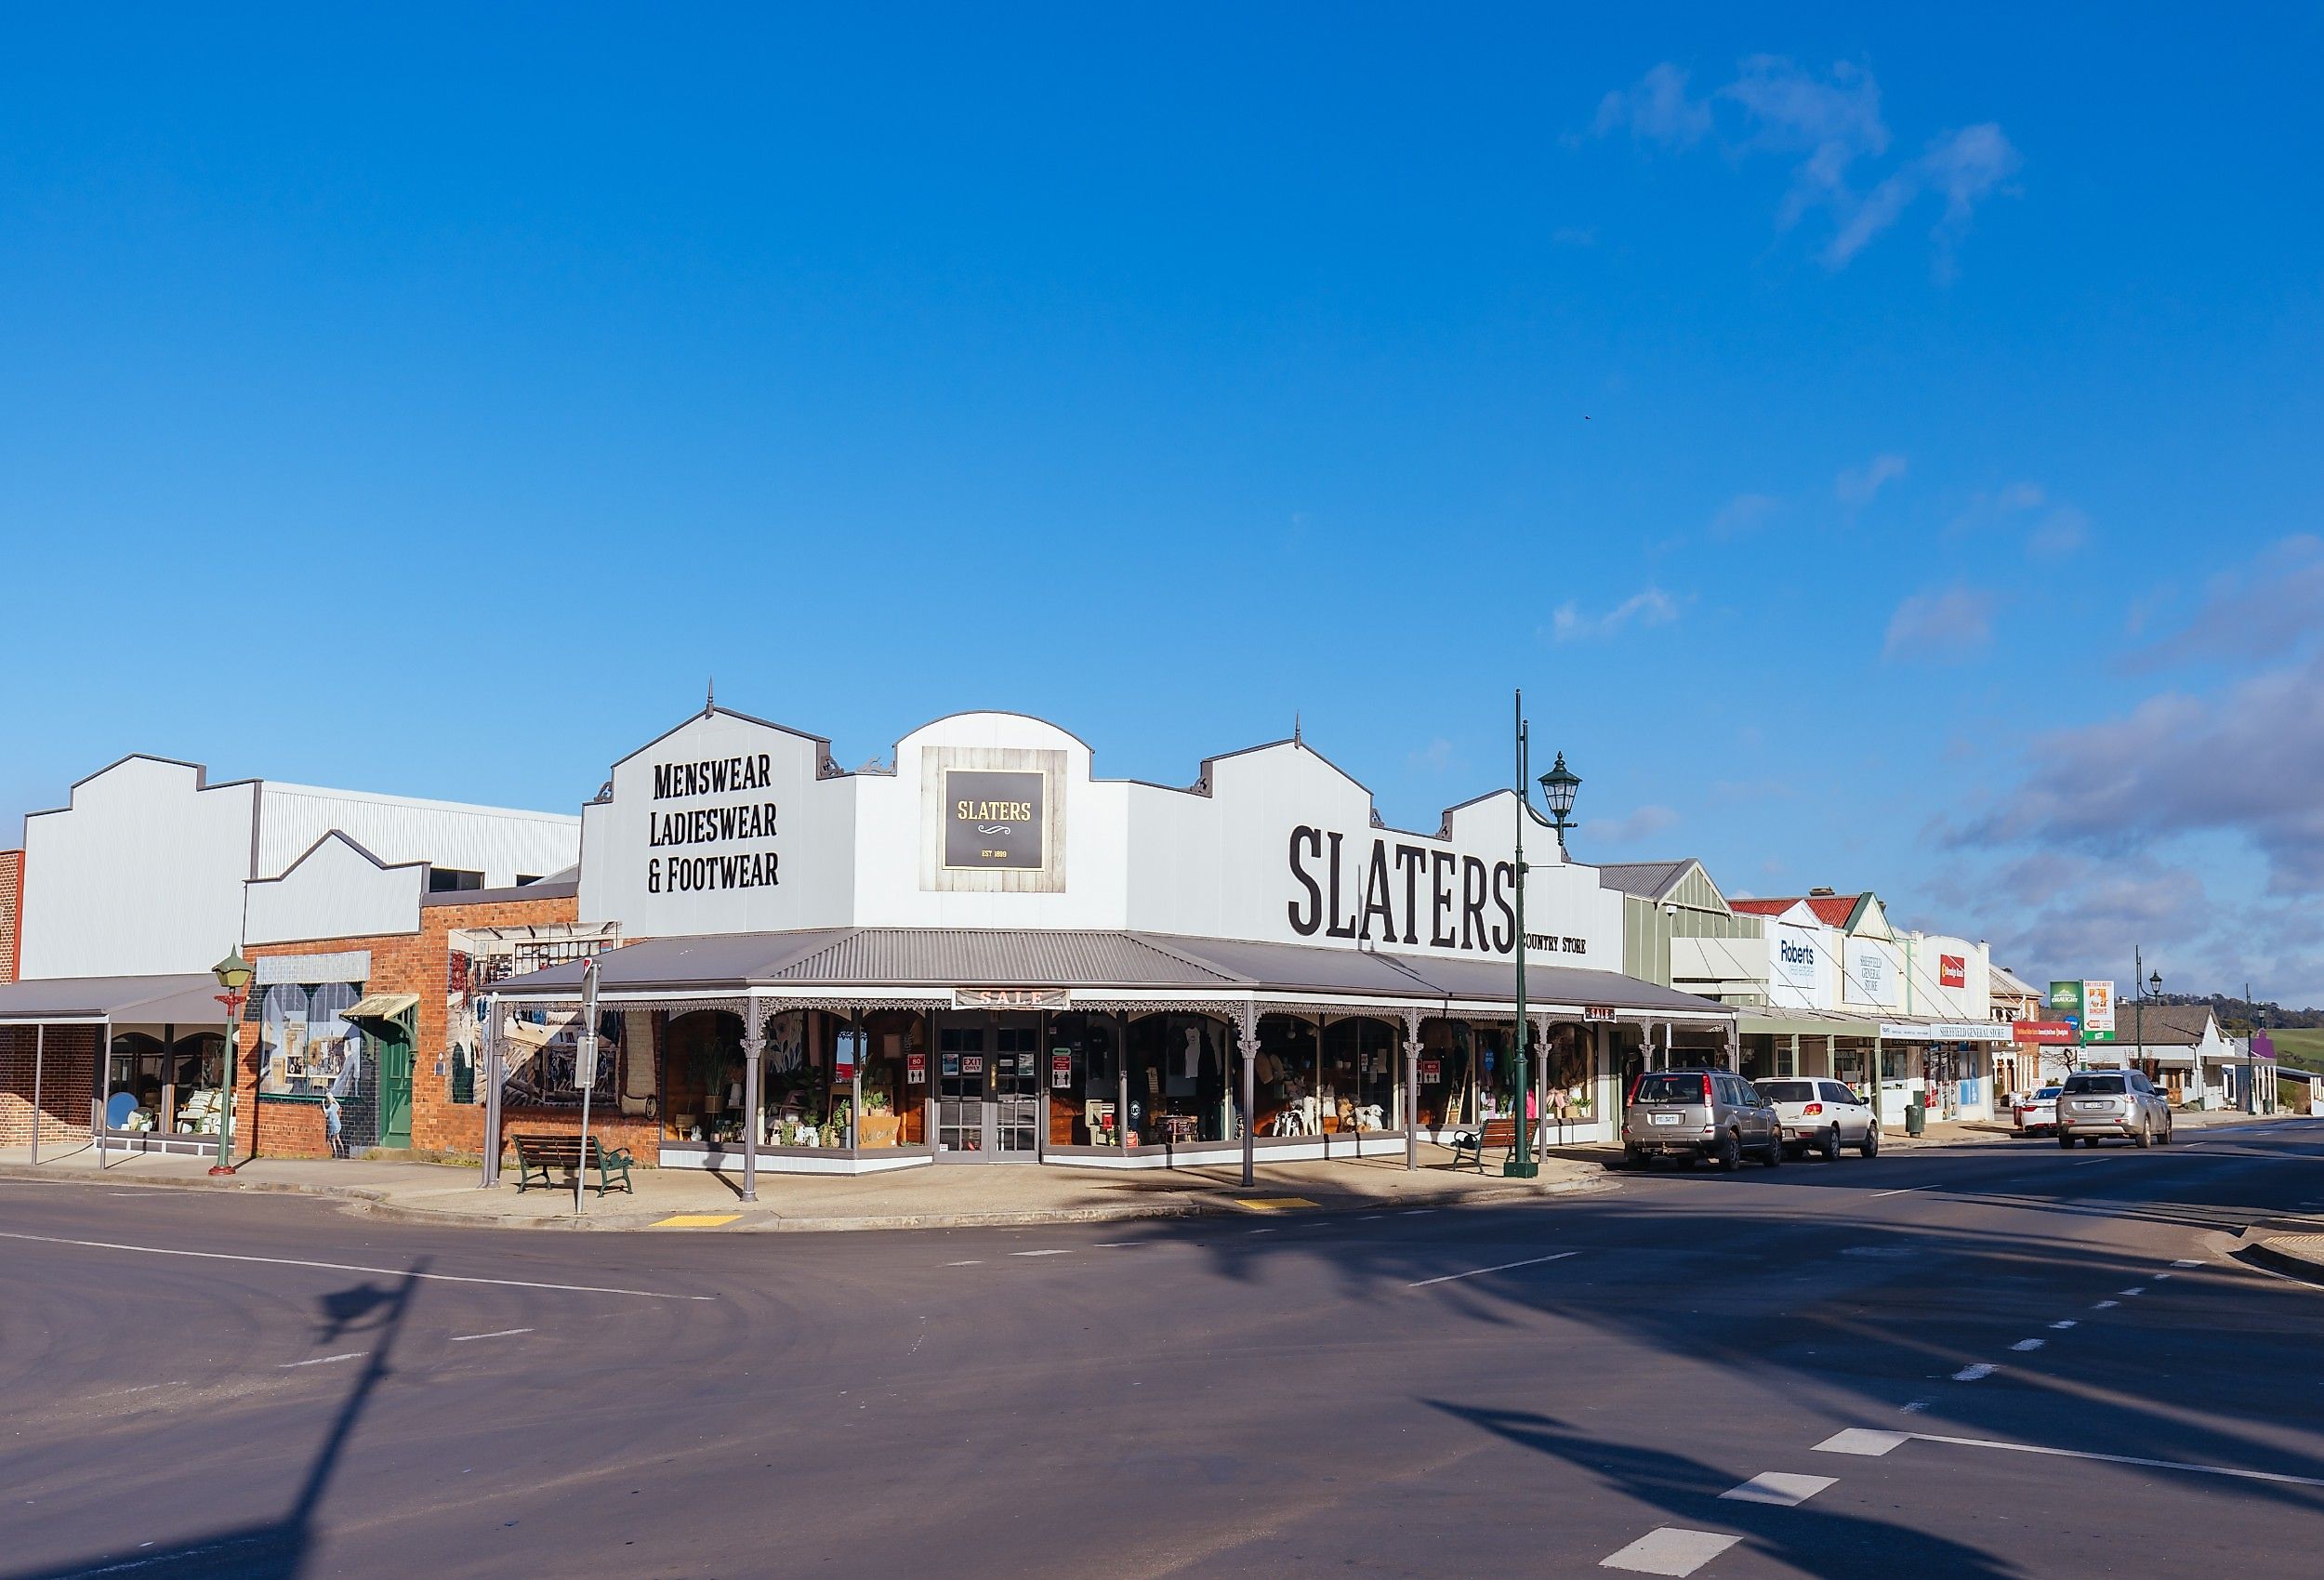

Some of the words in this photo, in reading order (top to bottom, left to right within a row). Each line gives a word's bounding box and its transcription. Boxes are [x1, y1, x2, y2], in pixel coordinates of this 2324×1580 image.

[654, 754, 772, 800] MENSWEAR
[957, 800, 1031, 821] SLATERS
[649, 802, 777, 847] LADIESWEAR
[648, 858, 661, 893] &
[667, 851, 780, 893] FOOTWEAR
[1287, 824, 1516, 955] SLATERS
[1524, 932, 1559, 952] OUNTRY
[1562, 936, 1587, 955] STORE
[1780, 939, 1814, 965] Roberts
[1860, 955, 1882, 968] SHEFFIELD
[1862, 968, 1881, 979] GENERAL
[1865, 980, 1878, 991] STORE
[980, 991, 1043, 1005] SALE
[1591, 1008, 1609, 1020] SALE
[1939, 1026, 1966, 1037] SHEFFIELD
[1967, 1027, 1989, 1038] GENERAL
[1989, 1028, 2005, 1038] STORE
[963, 1058, 982, 1066] EXIT
